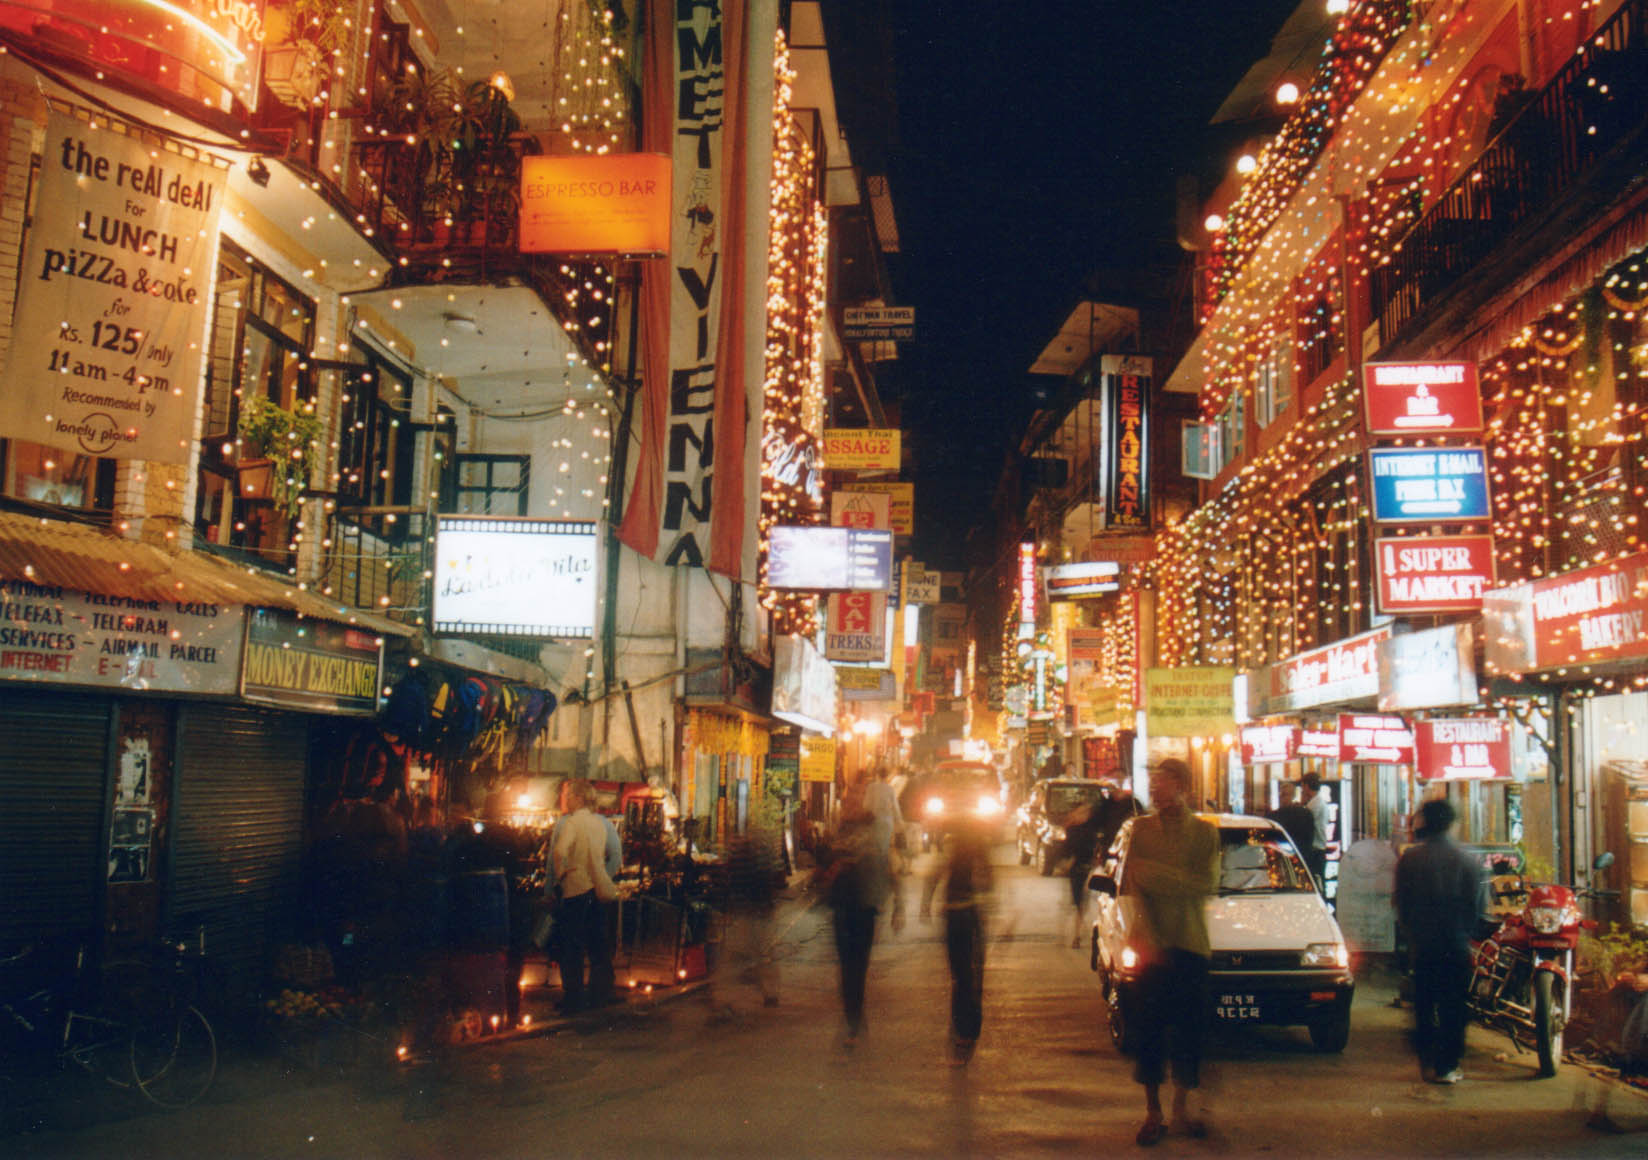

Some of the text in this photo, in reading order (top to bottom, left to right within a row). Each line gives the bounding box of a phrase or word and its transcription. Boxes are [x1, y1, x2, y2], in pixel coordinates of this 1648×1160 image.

[61, 136, 110, 182] the
[619, 179, 657, 196] BAR
[125, 199, 147, 218] For
[82, 209, 179, 265] LUNCH
[144, 402, 157, 418] by
[664, 250, 719, 568] VIENNA
[55, 419, 139, 445] lonely planet
[1120, 375, 1141, 516] RESTAURANT
[1399, 546, 1473, 572] SUPER
[1389, 575, 1486, 602] MARKET
[92, 612, 168, 636] TELEGRAM
[0, 627, 76, 651] SERVICES
[100, 637, 161, 659] AIRMAIL
[169, 643, 218, 664] PARCEL
[829, 633, 873, 650] TREKS
[246, 642, 377, 698] MONEY EXCHANGE
[1433, 721, 1502, 743] RESTAURANT
